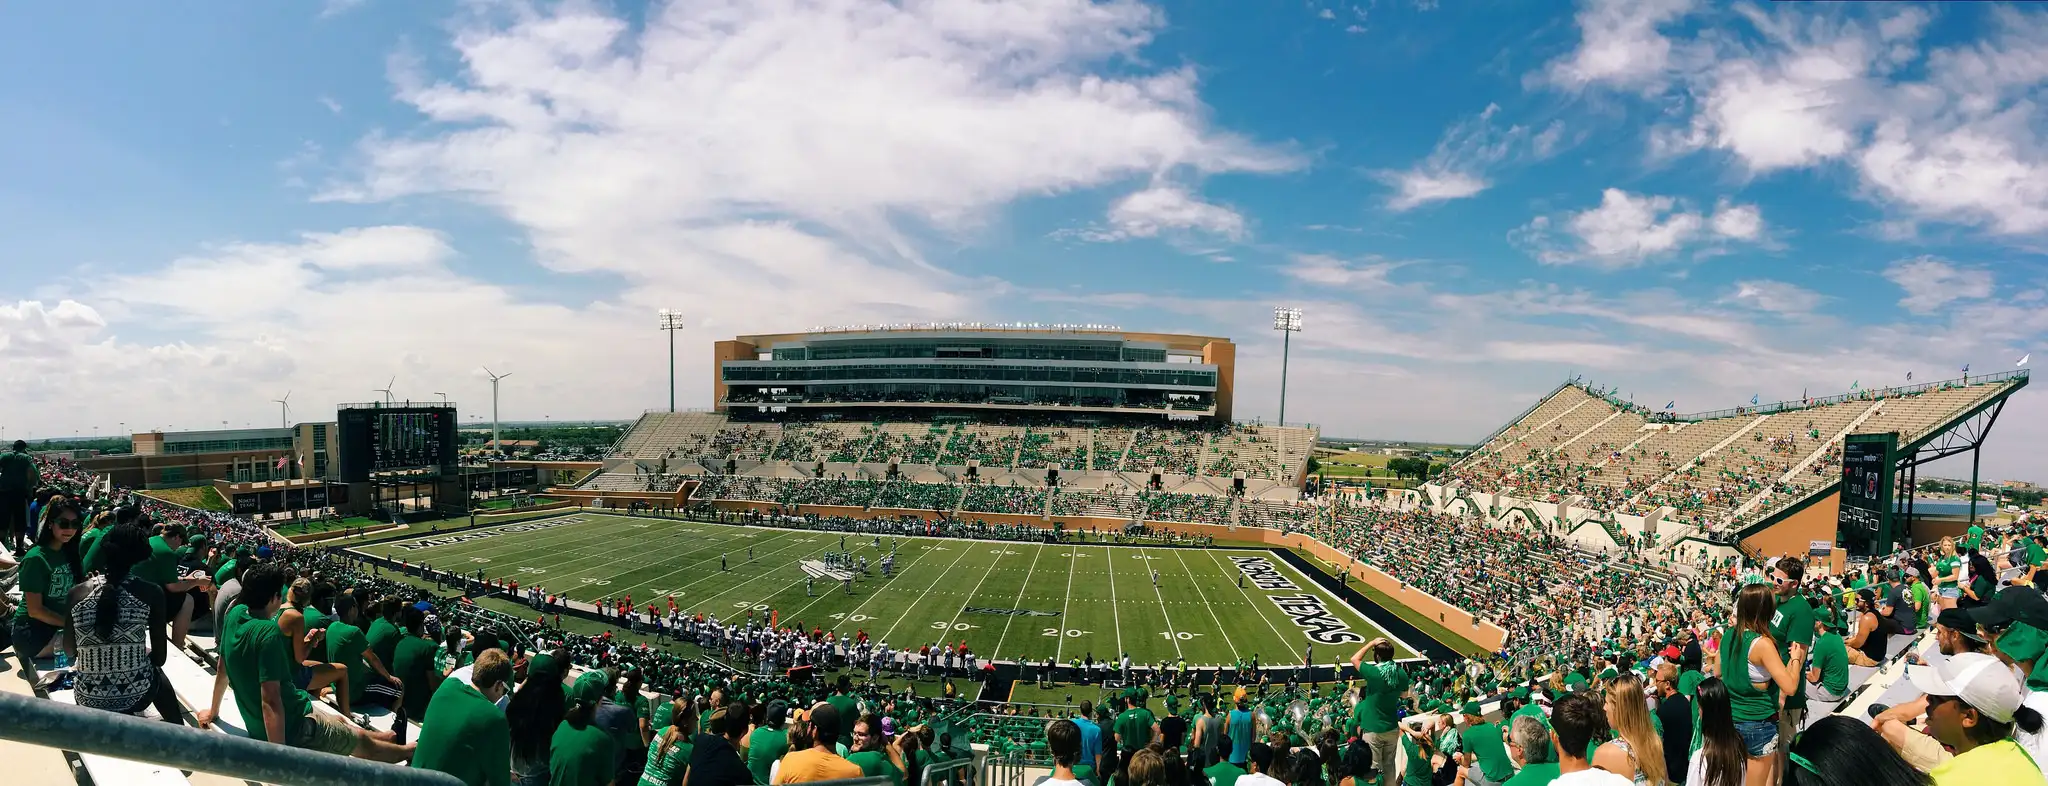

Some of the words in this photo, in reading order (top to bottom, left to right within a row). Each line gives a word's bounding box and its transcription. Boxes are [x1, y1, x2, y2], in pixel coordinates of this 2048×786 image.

[1227, 555, 1302, 591] NORTH
[733, 601, 770, 611] 50
[829, 612, 867, 622] 40
[1266, 593, 1365, 645] TEXAS
[930, 621, 970, 631] 30
[1042, 628, 1083, 638] 20
[1159, 631, 1194, 640] 10
